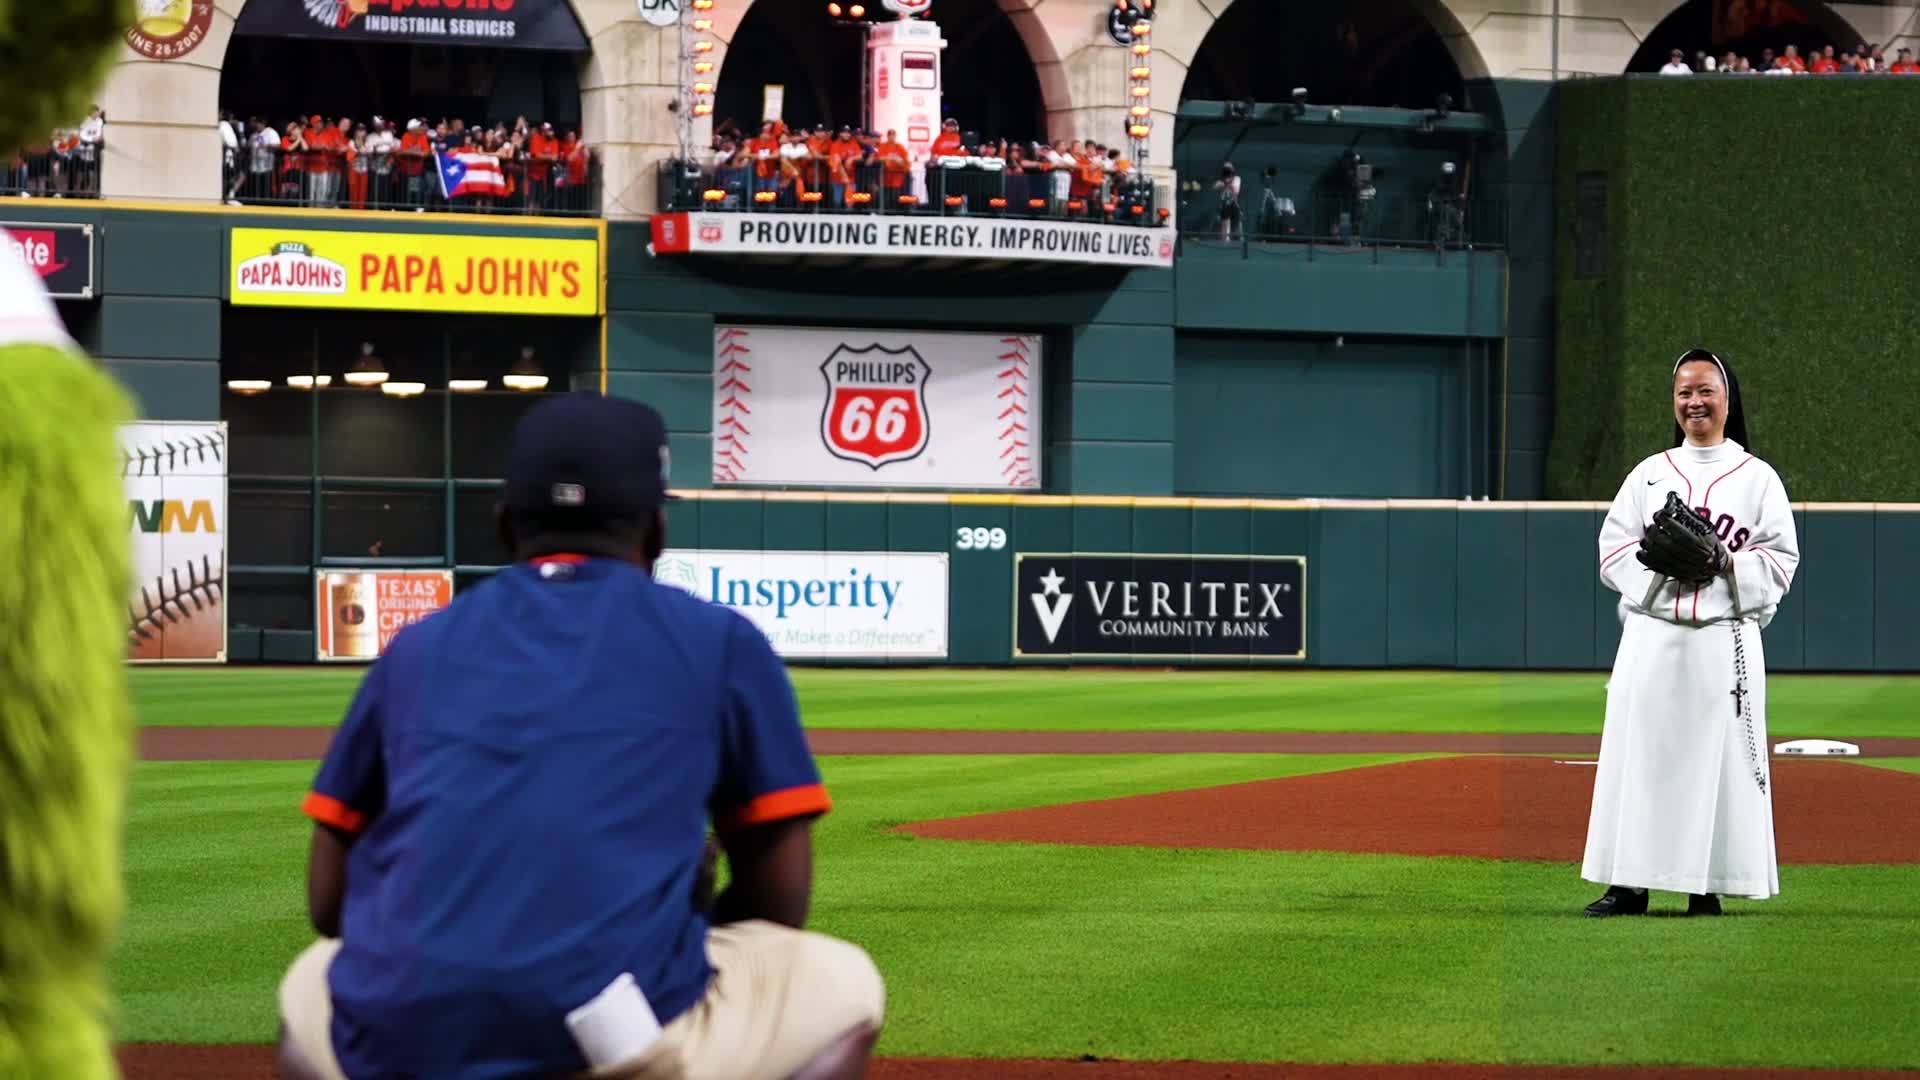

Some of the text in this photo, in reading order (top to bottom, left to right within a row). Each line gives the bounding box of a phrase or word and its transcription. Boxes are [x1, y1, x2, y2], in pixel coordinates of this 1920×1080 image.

[365, 15, 515, 37] INDUSTRIAL SERVICES
[127, 26, 153, 52] UNE
[280, 243, 304, 252] PIZZA
[739, 220, 878, 245] PROVIDING
[888, 224, 982, 248] ENERGY.
[991, 227, 1101, 253] IMPROVING
[1108, 233, 1154, 257] LIVES.
[241, 261, 281, 286] PAPA
[361, 253, 580, 299] PAPA JOHN'S
[837, 361, 916, 384] PHILLIPS
[840, 395, 911, 443] 66
[956, 526, 1007, 551] 399
[379, 597, 440, 609] ORIGINAL
[709, 565, 902, 621] Insperity
[785, 629, 832, 645] Makes
[833, 633, 844, 645] a
[1100, 620, 1270, 638] COMMUNITY BANK
